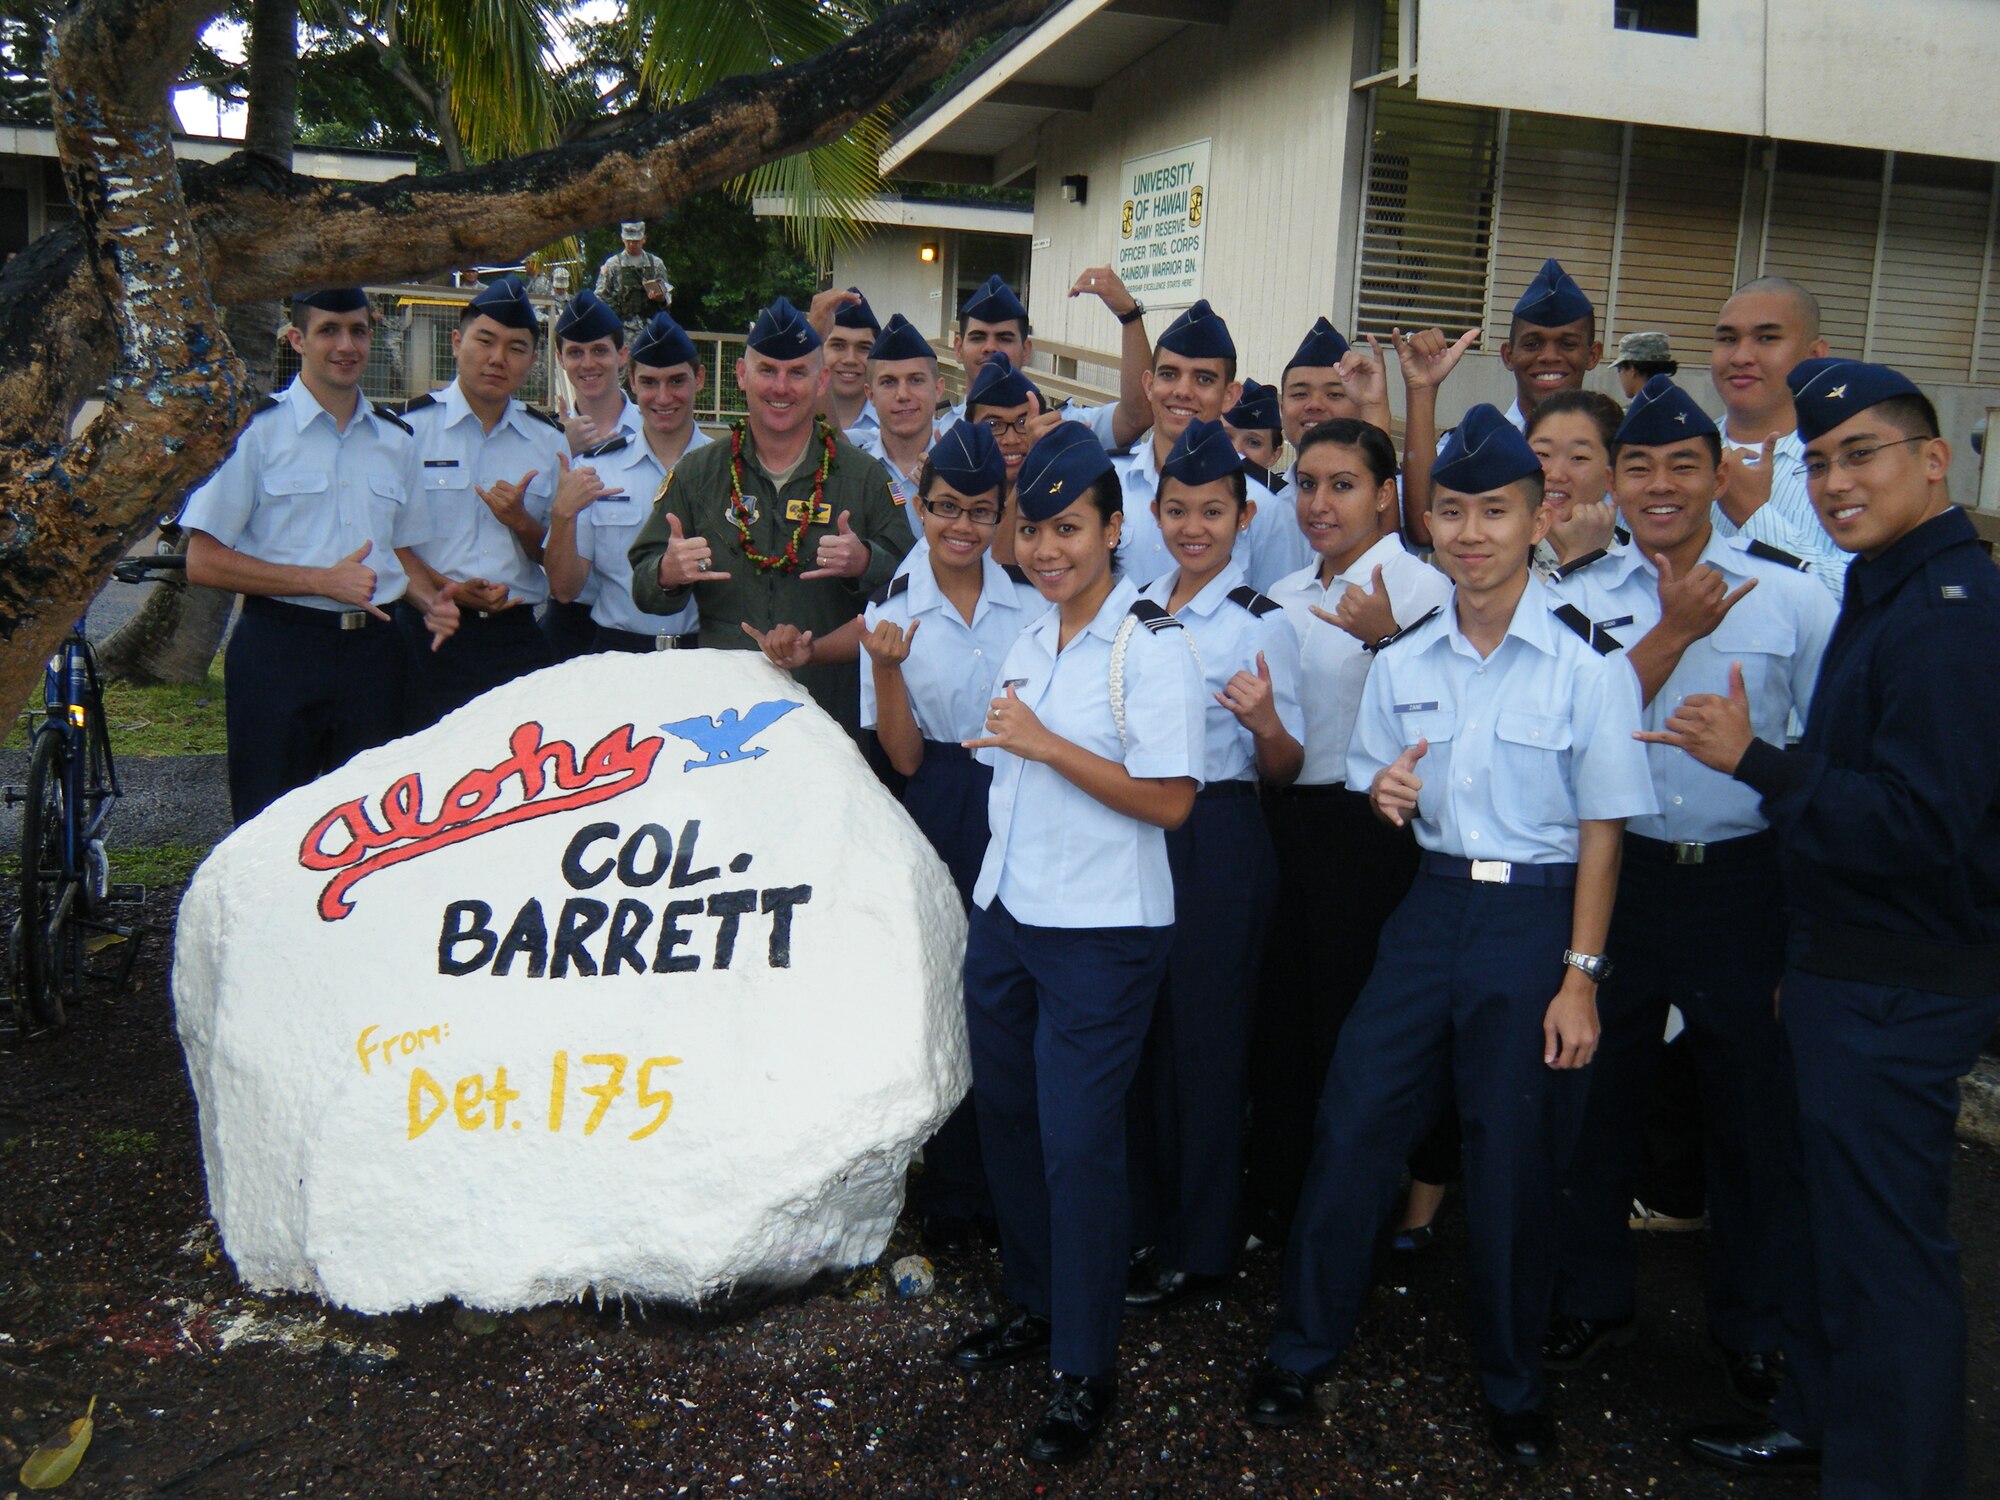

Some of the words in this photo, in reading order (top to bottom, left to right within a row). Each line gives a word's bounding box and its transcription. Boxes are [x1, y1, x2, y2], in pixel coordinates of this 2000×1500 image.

[1133, 161, 1195, 196] UNIVERSITY
[1135, 199, 1150, 222] OF
[1153, 190, 1188, 218] HAWAII
[1133, 224, 1153, 241] ARMY
[1155, 218, 1186, 237] RESERVE
[1120, 245, 1146, 263] OFFICER
[1170, 235, 1200, 255] CORPS
[1120, 263, 1151, 281] RAINBOW
[1152, 260, 1182, 278] WARRIOR
[1184, 258, 1197, 274] BN.
[561, 819, 753, 890] COL.
[438, 885, 812, 979] BARRETT
[357, 1023, 450, 1075] From:
[407, 1066, 522, 1140] Det.
[548, 1050, 684, 1140] 175
